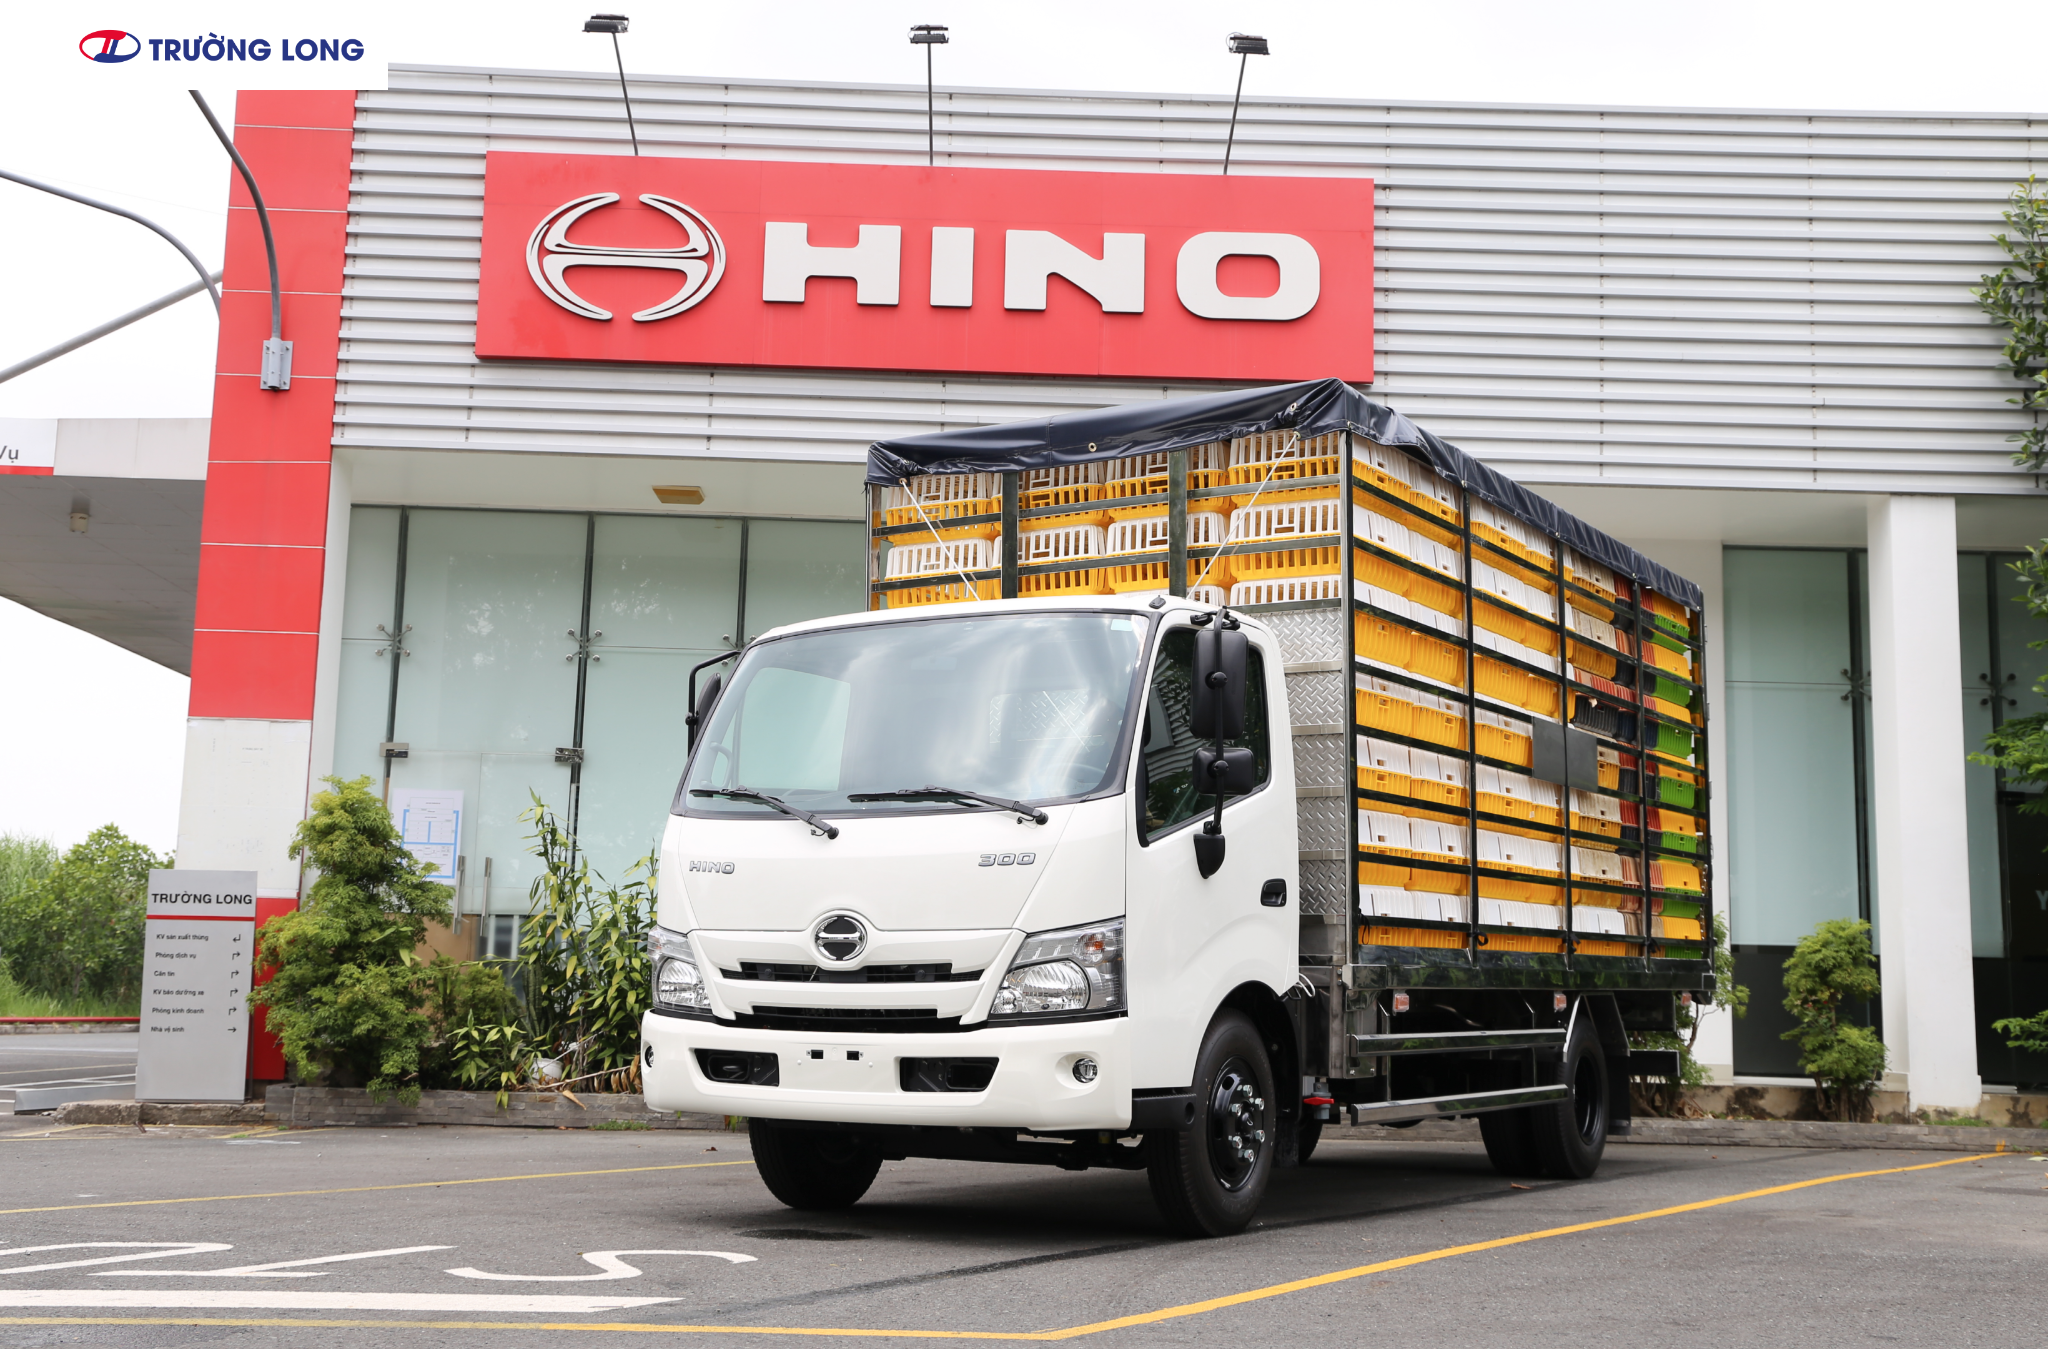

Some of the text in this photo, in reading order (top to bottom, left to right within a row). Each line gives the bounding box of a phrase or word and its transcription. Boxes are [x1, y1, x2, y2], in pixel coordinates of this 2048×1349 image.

[762, 221, 1320, 320] HINO
[978, 853, 1036, 867] 300
[689, 860, 735, 875] HINO
[151, 891, 252, 904] TRƯỜNG LONG
